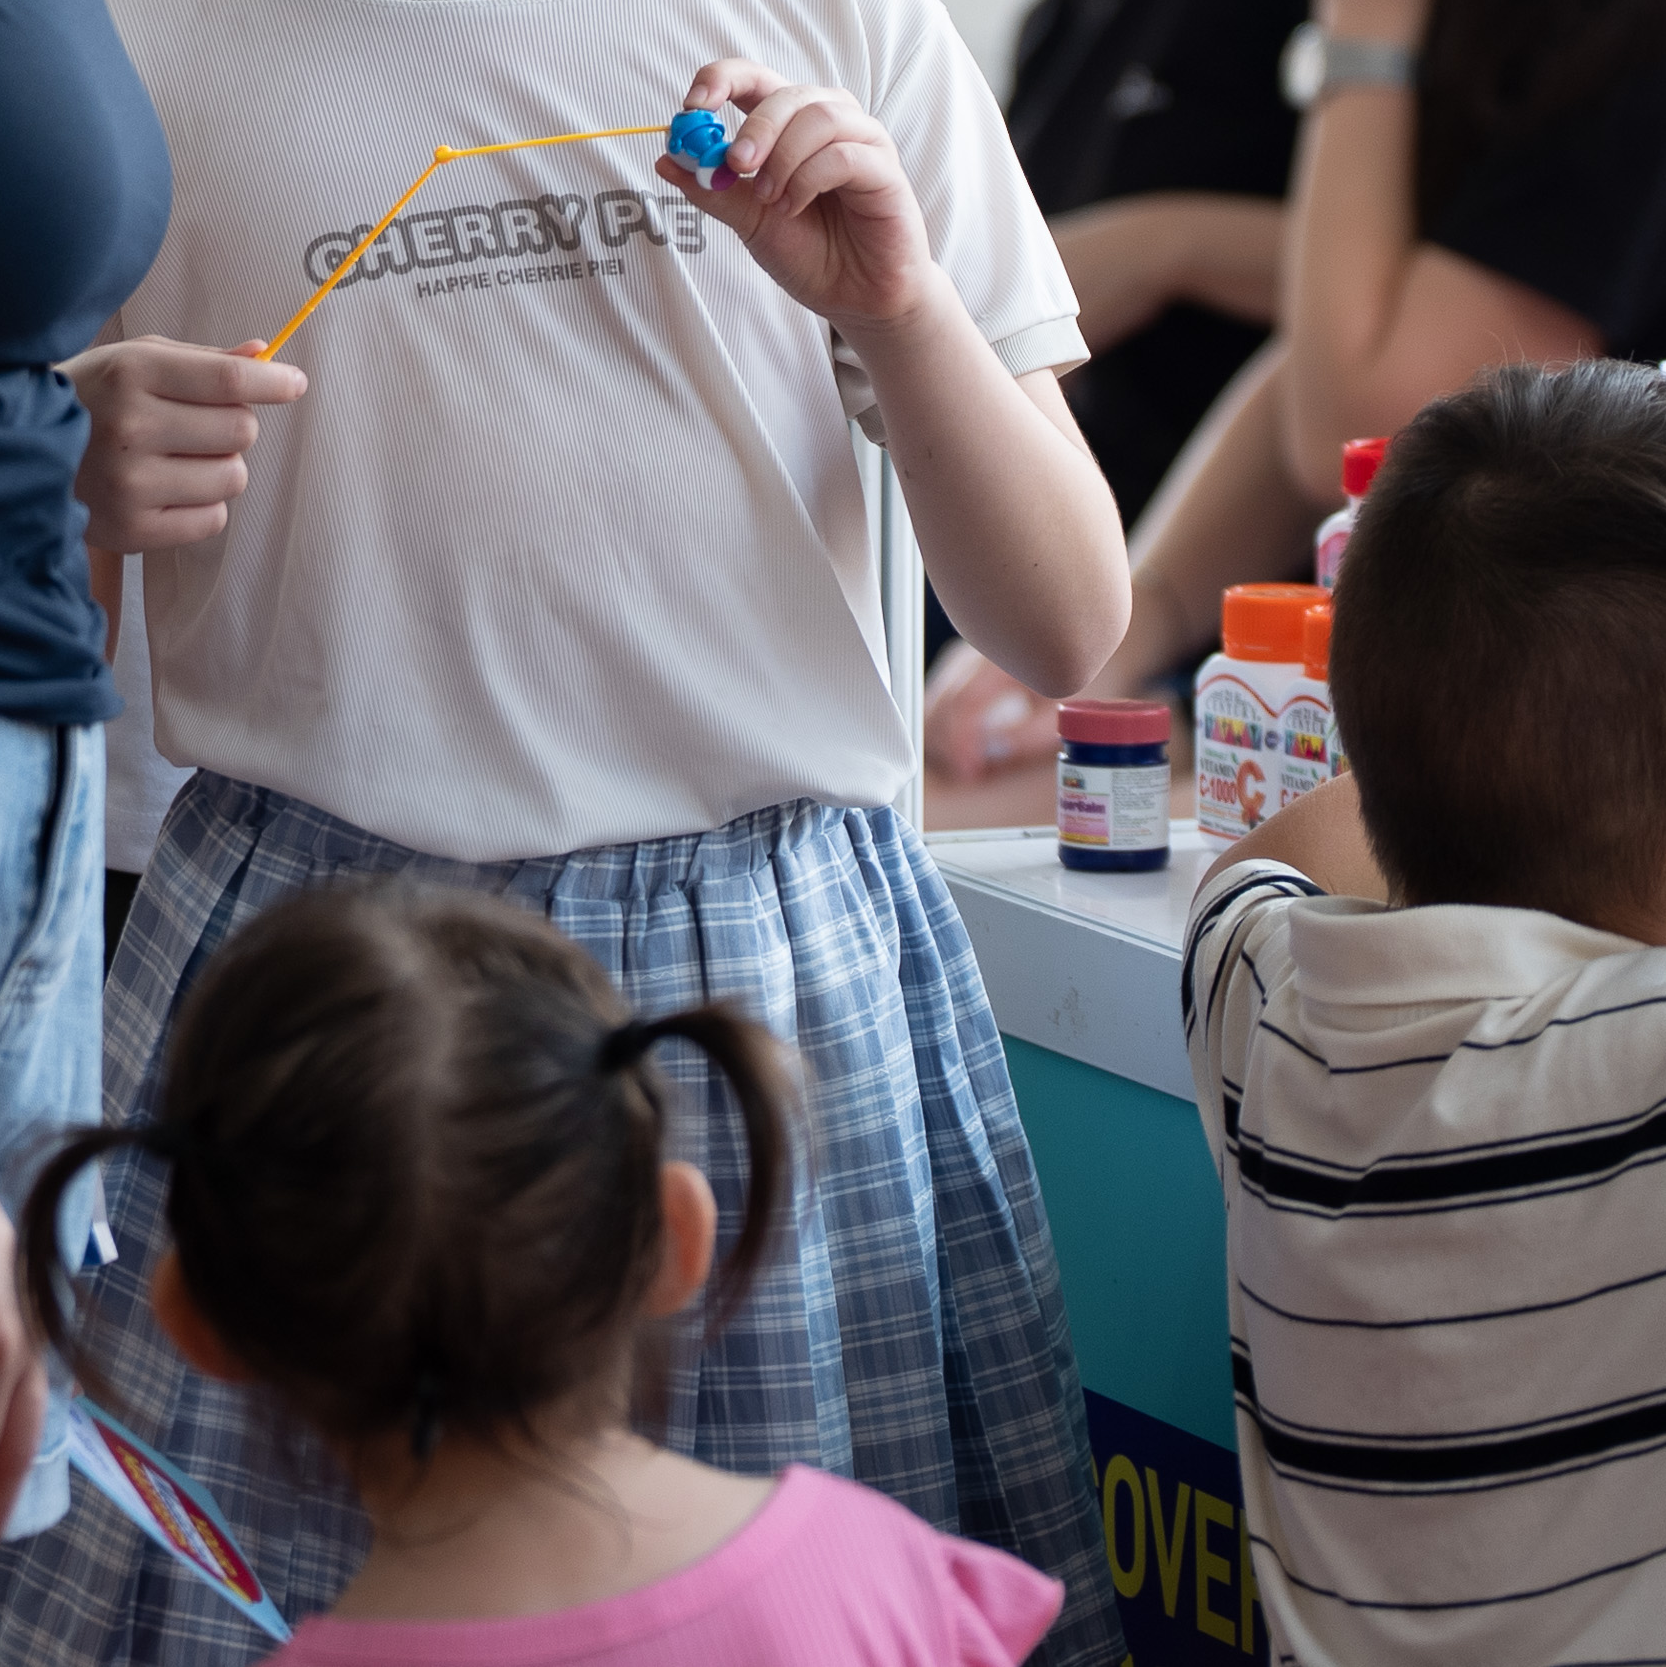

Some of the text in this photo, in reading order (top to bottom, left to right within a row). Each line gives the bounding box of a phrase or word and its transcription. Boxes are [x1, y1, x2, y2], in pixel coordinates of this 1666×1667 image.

[303, 189, 707, 289] CHERRY PIE
[417, 271, 492, 299] HAPPIE
[496, 261, 584, 288] CHERRIE
[1091, 1453, 1260, 1656] OVE
